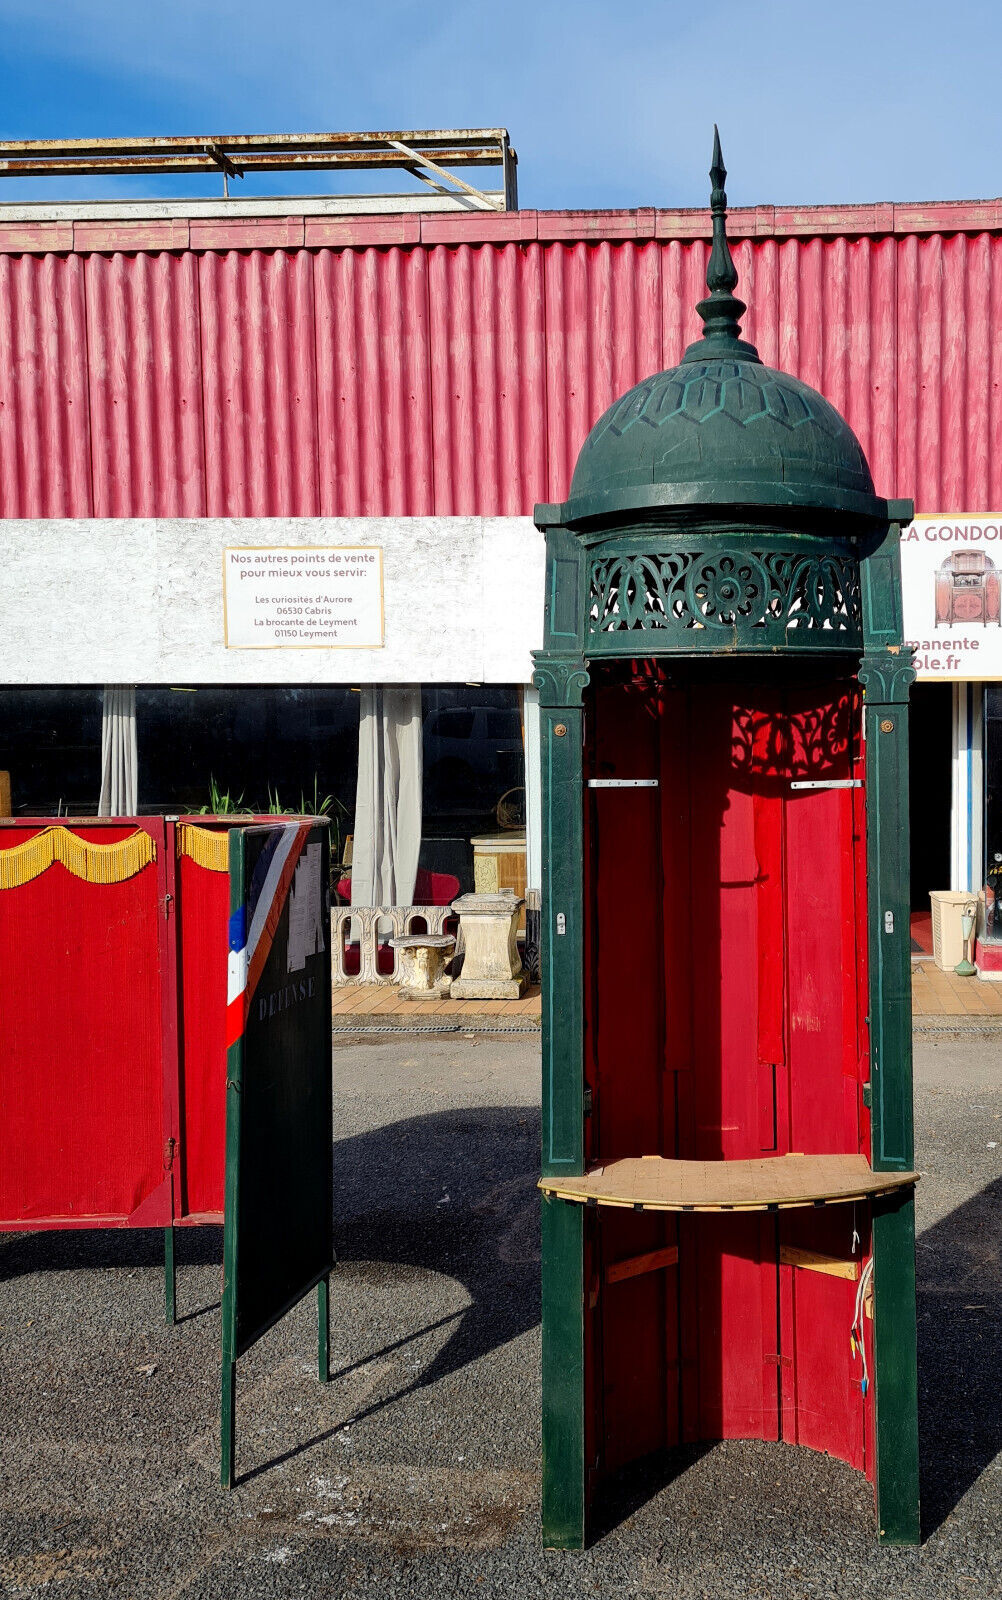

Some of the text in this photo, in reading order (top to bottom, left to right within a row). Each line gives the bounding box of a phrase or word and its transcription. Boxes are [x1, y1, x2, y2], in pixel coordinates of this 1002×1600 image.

[924, 525, 1002, 541] GONDO
[230, 553, 376, 566] Nos autres points de vente
[240, 567, 367, 581] pour mieux vous servir:
[255, 595, 270, 604] Les
[315, 594, 353, 604] d'Aurore
[276, 606, 332, 615] 06530 Cabris
[254, 617, 358, 628] La brocante de Leyment
[274, 629, 338, 640] 01150 Leyment
